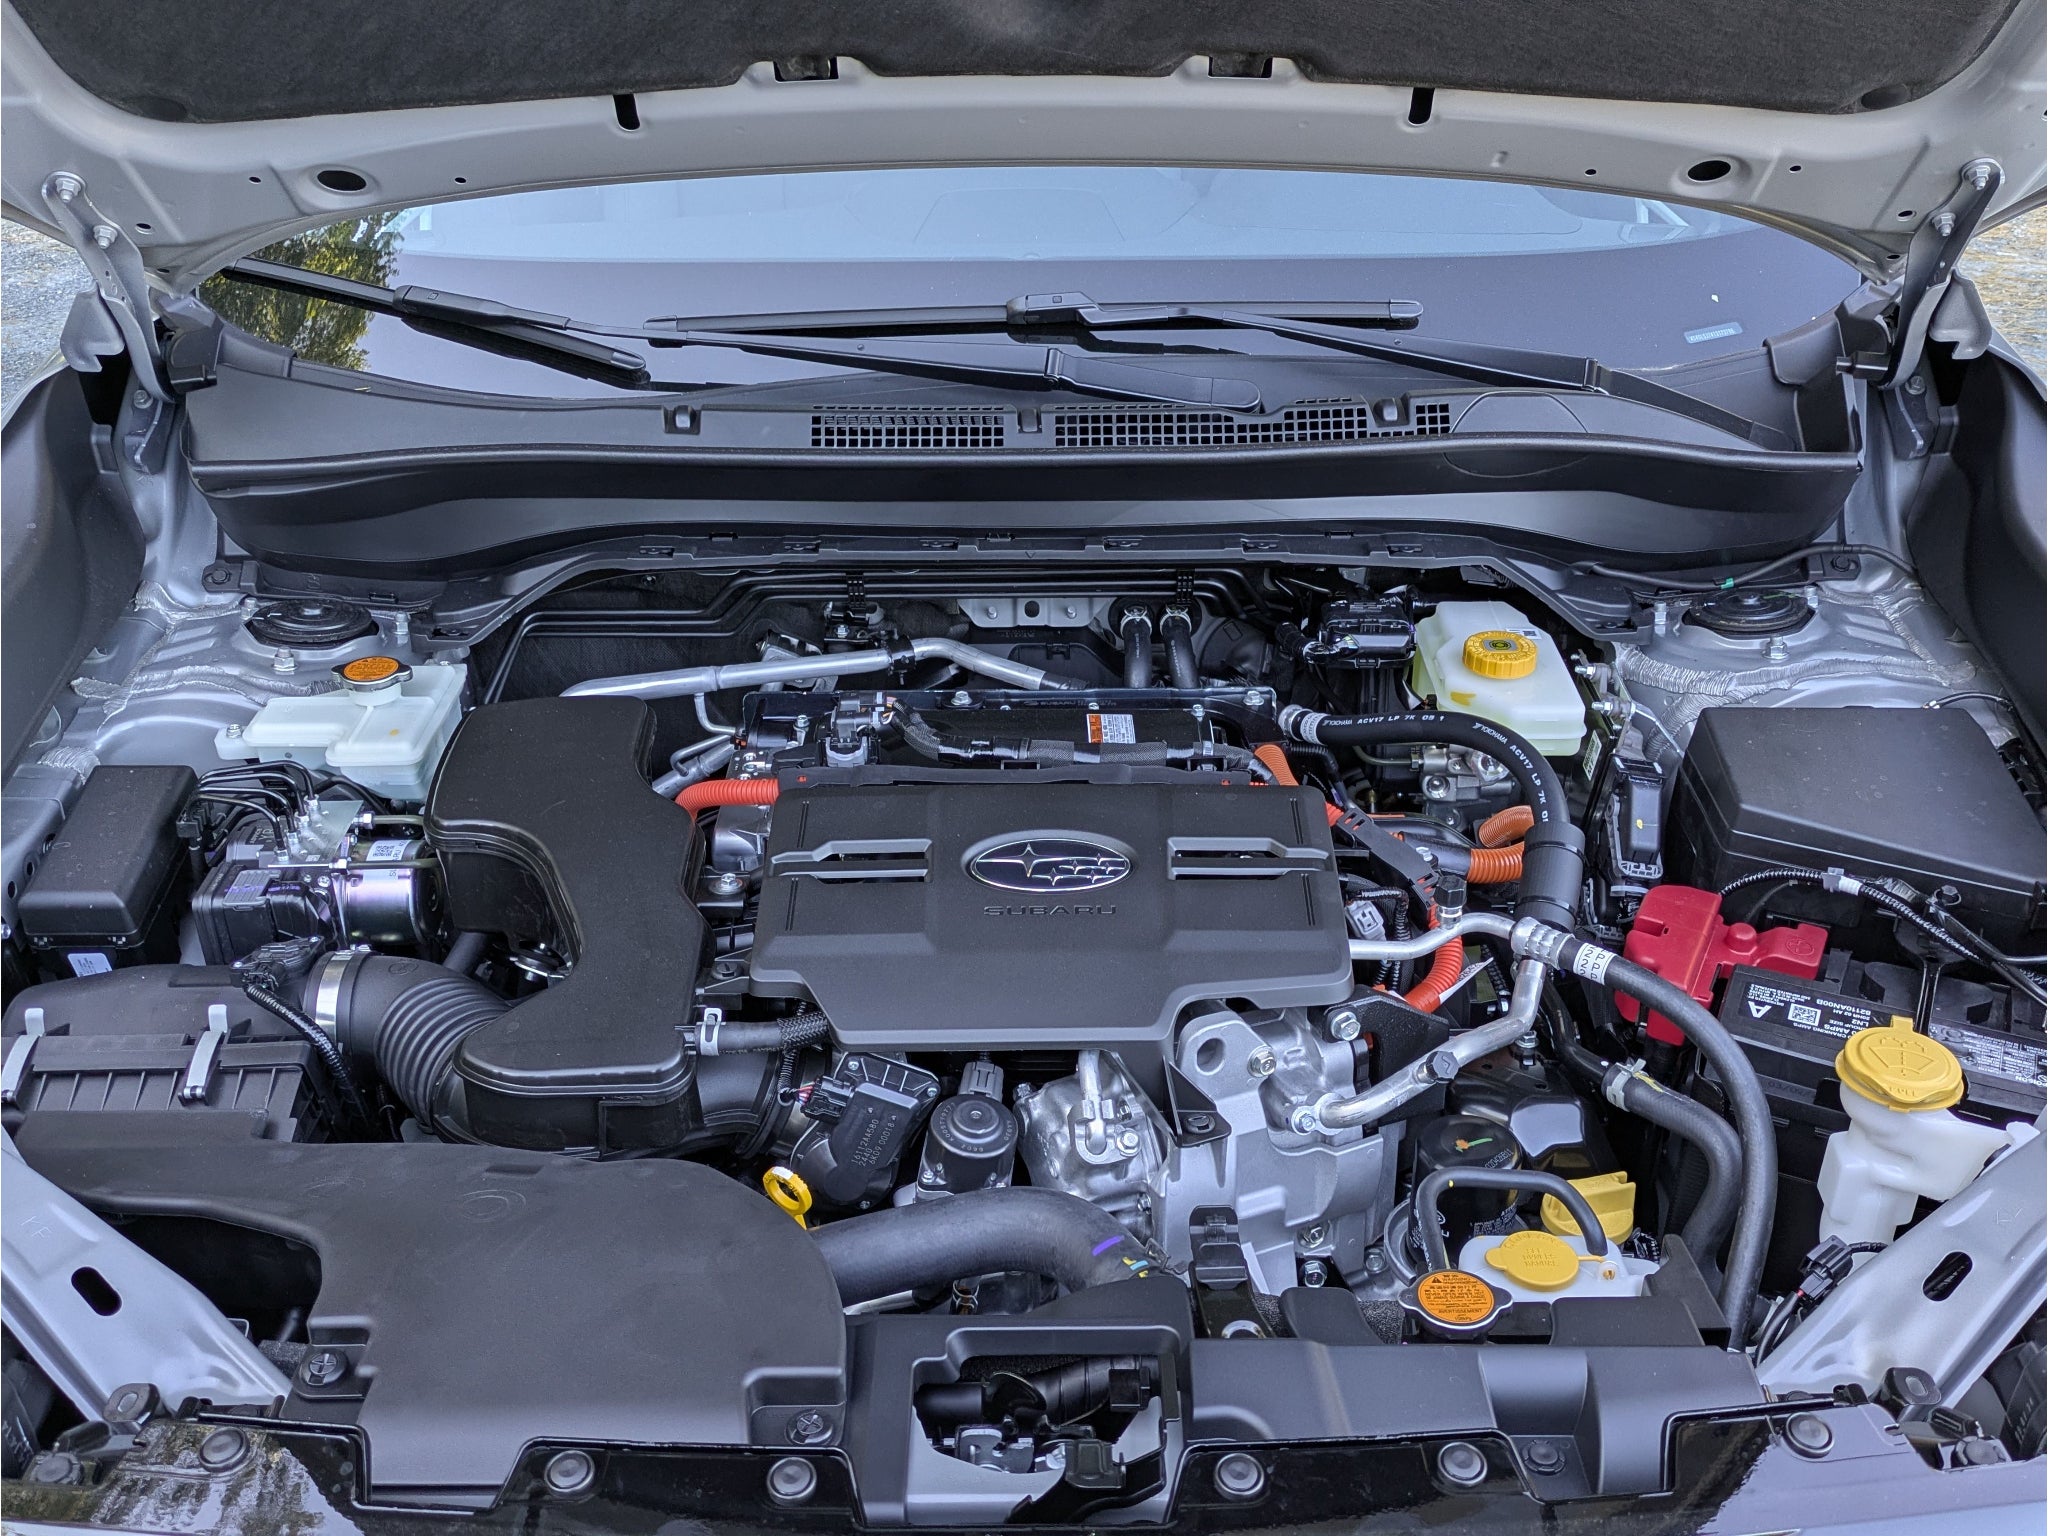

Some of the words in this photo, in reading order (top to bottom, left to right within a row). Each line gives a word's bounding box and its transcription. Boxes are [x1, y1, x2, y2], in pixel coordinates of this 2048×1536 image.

[1509, 745, 1533, 769] ACV17
[984, 904, 1117, 916] SUBARU
[1852, 1019, 1869, 1027] LN2
[1824, 1024, 1850, 1034] AMPS
